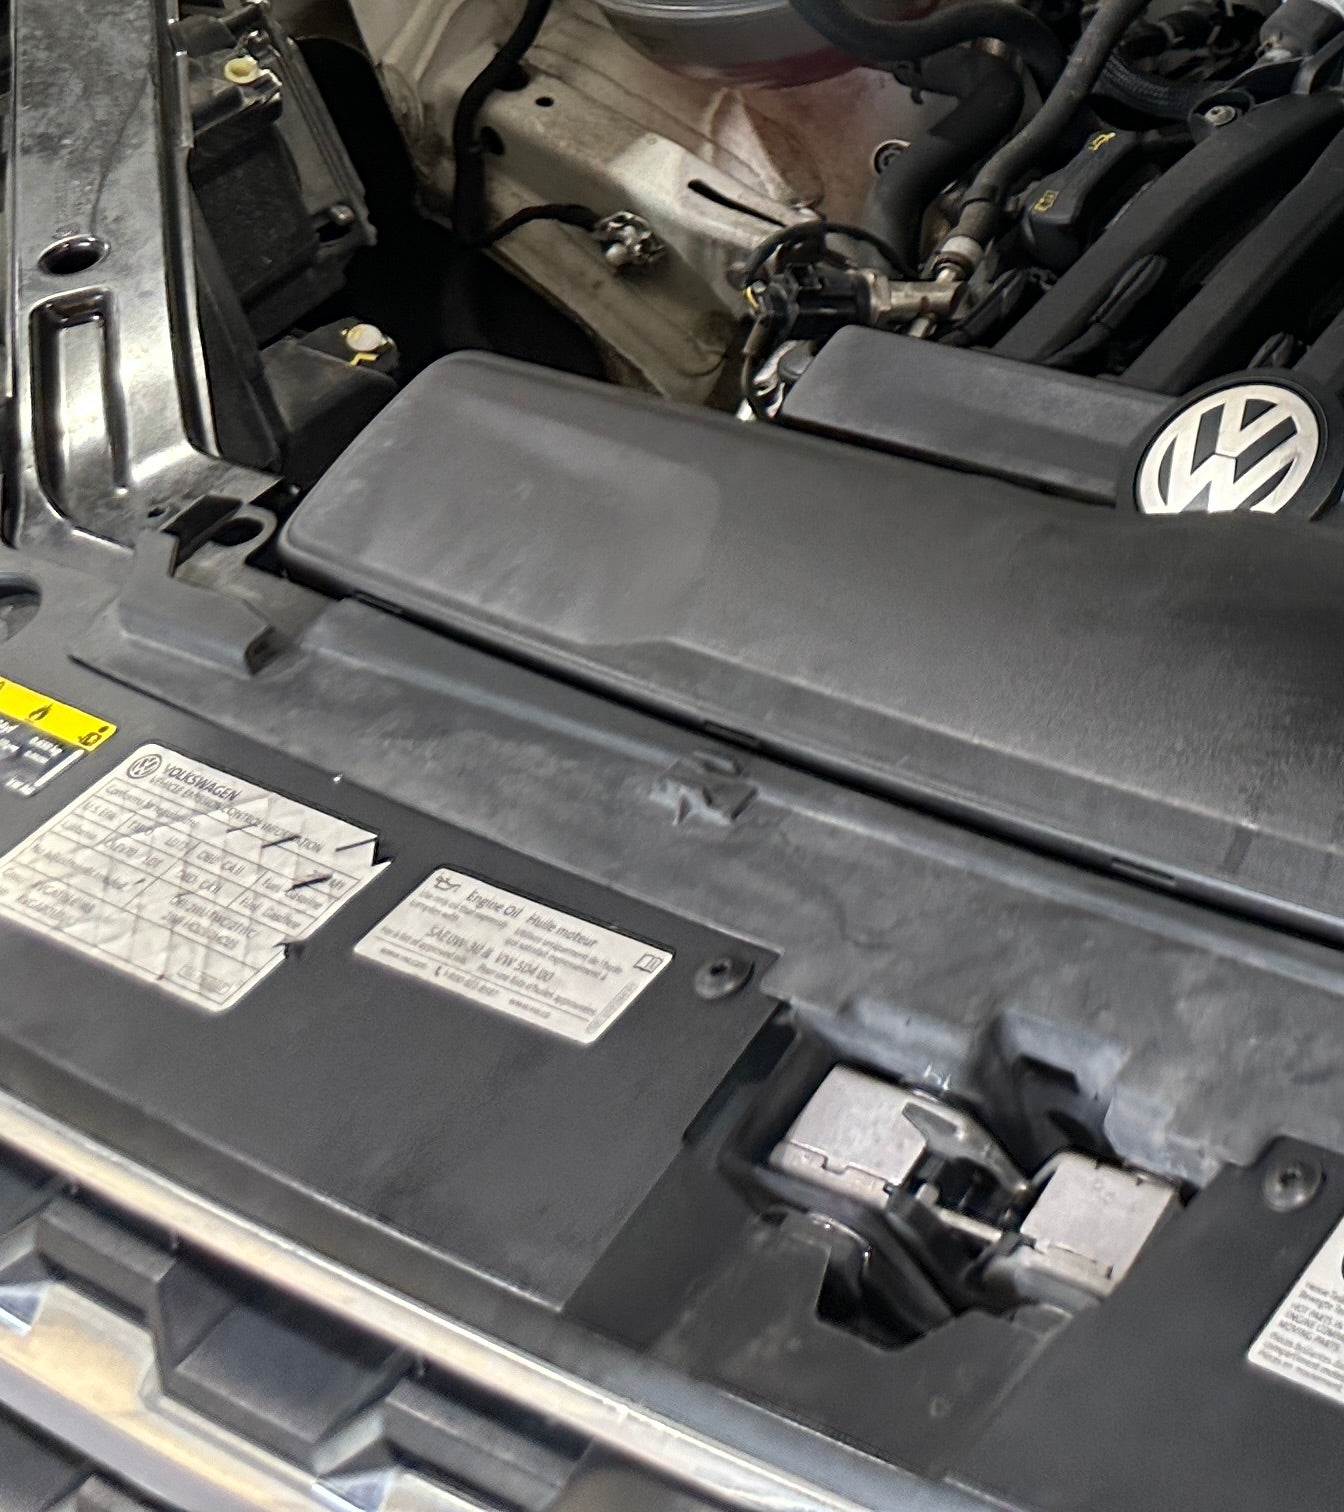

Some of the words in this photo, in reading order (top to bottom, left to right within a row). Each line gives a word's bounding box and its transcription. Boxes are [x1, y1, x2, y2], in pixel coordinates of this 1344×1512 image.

[157, 763, 243, 801] VOLKSWAGEN
[462, 889, 508, 914] Engine
[501, 903, 525, 918] Oil
[524, 912, 561, 932] Huile
[553, 925, 600, 948] moteur
